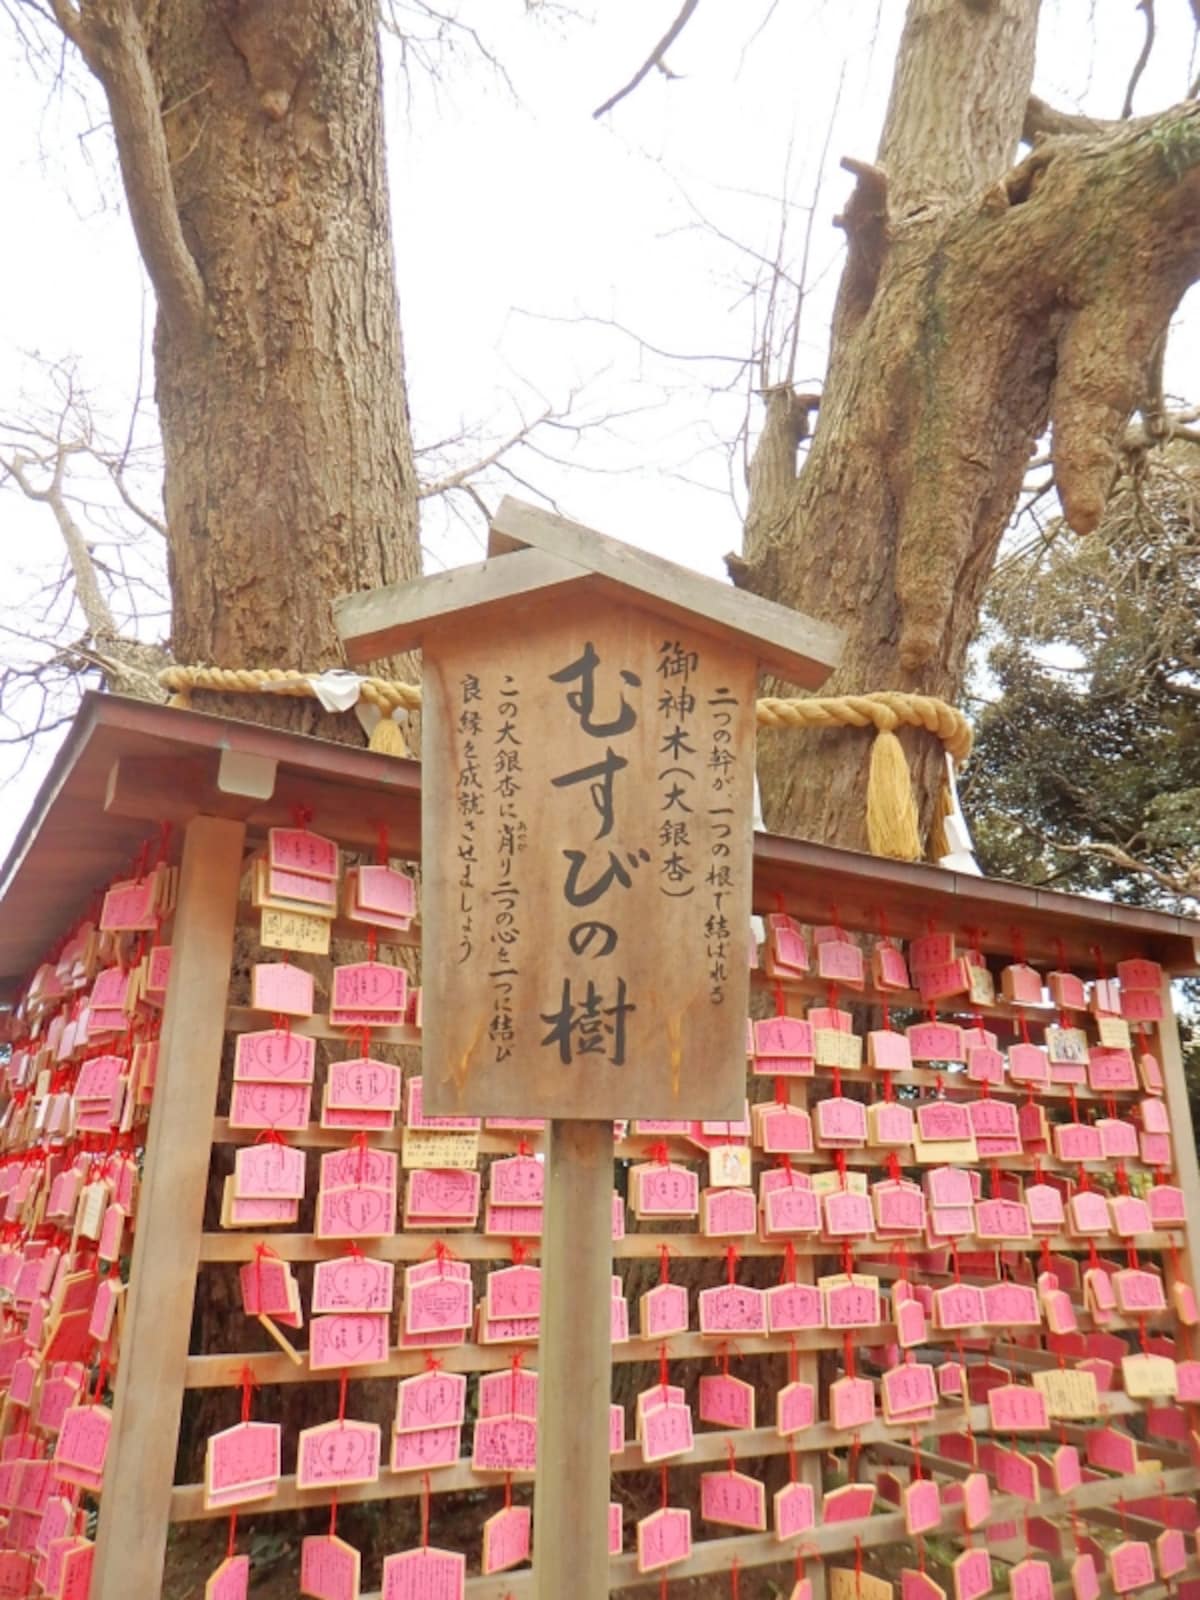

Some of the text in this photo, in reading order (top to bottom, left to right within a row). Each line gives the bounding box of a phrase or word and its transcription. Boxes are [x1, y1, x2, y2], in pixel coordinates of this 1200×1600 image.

[457, 673, 485, 964] 良縁を成就させましょう
[539, 641, 650, 1066] むすびの樹
